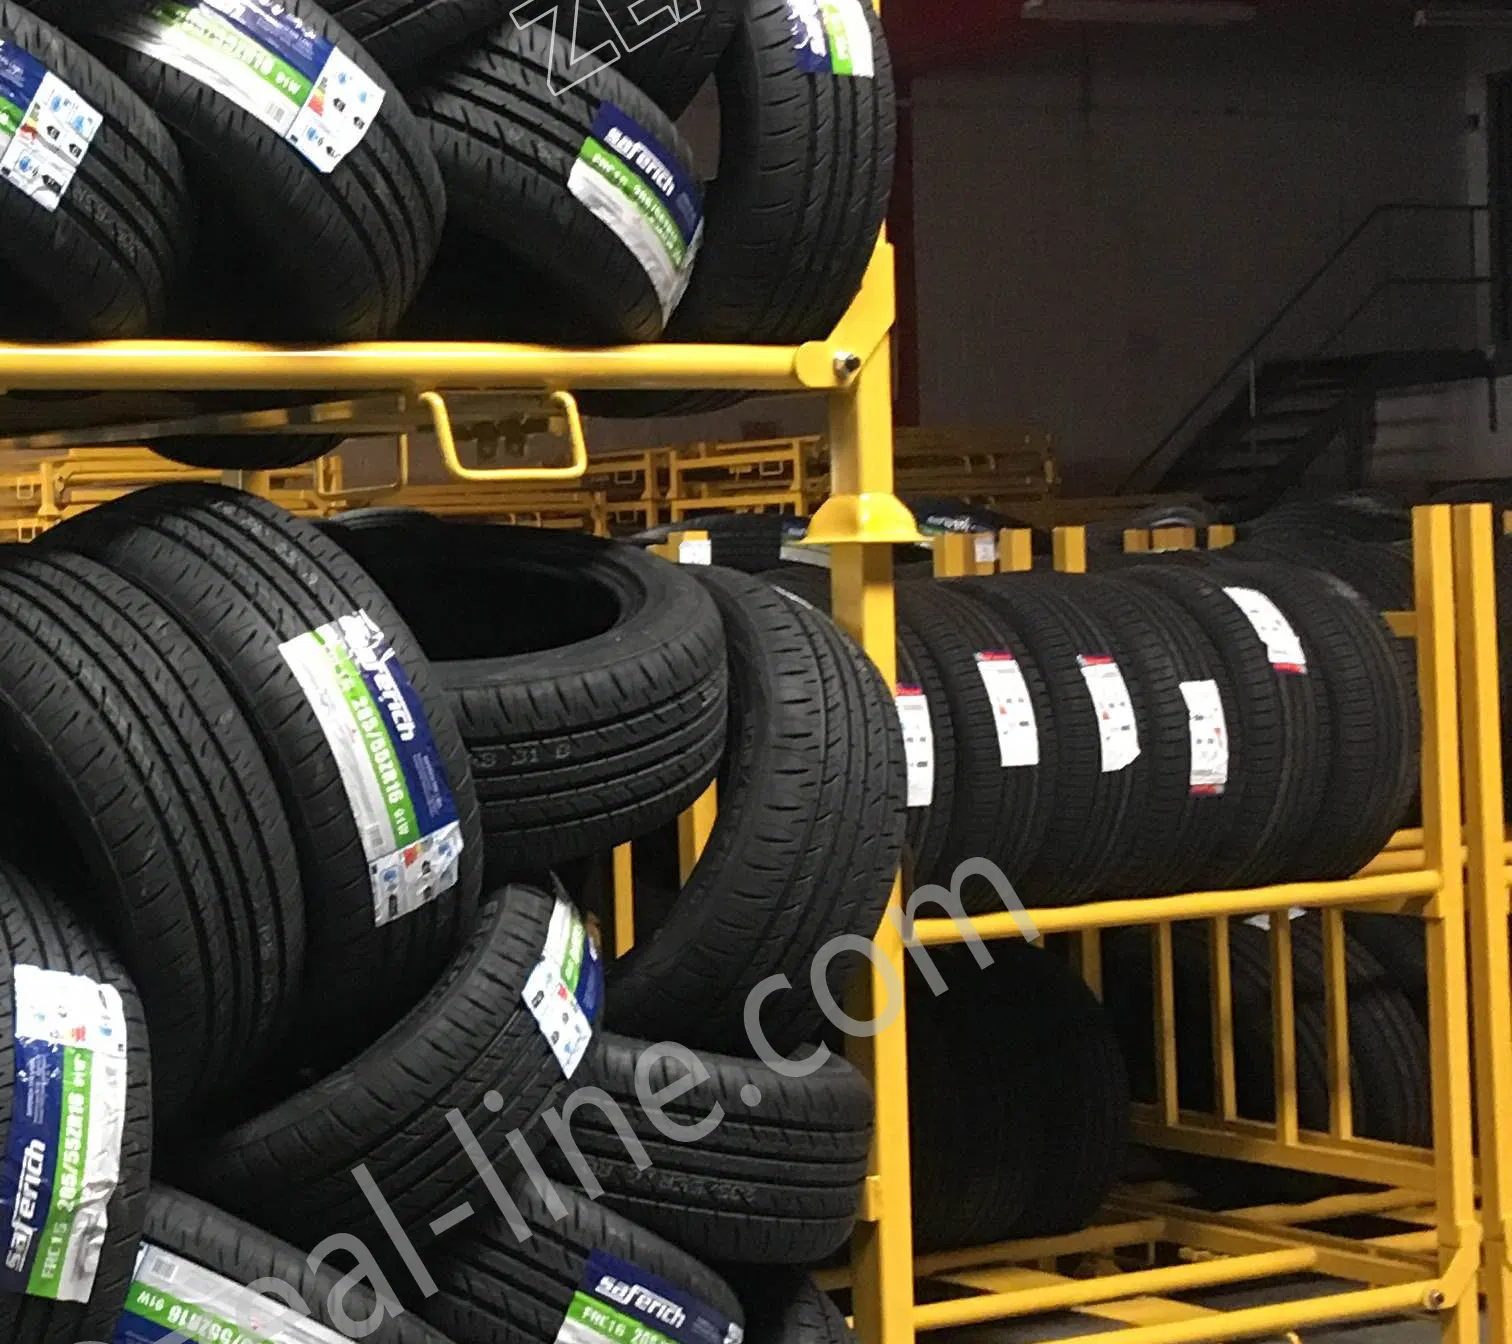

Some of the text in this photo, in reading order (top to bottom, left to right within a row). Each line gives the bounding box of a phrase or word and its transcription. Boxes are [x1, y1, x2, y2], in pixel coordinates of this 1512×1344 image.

[273, 69, 301, 95] 91W
[4, 1138, 46, 1272] saferich
[40, 1221, 68, 1279] FRC16
[56, 1092, 86, 1211] 205/55ZR16
[136, 1288, 165, 1312] 91W
[579, 1306, 626, 1337] FRC16
[593, 1270, 688, 1330] saferich
